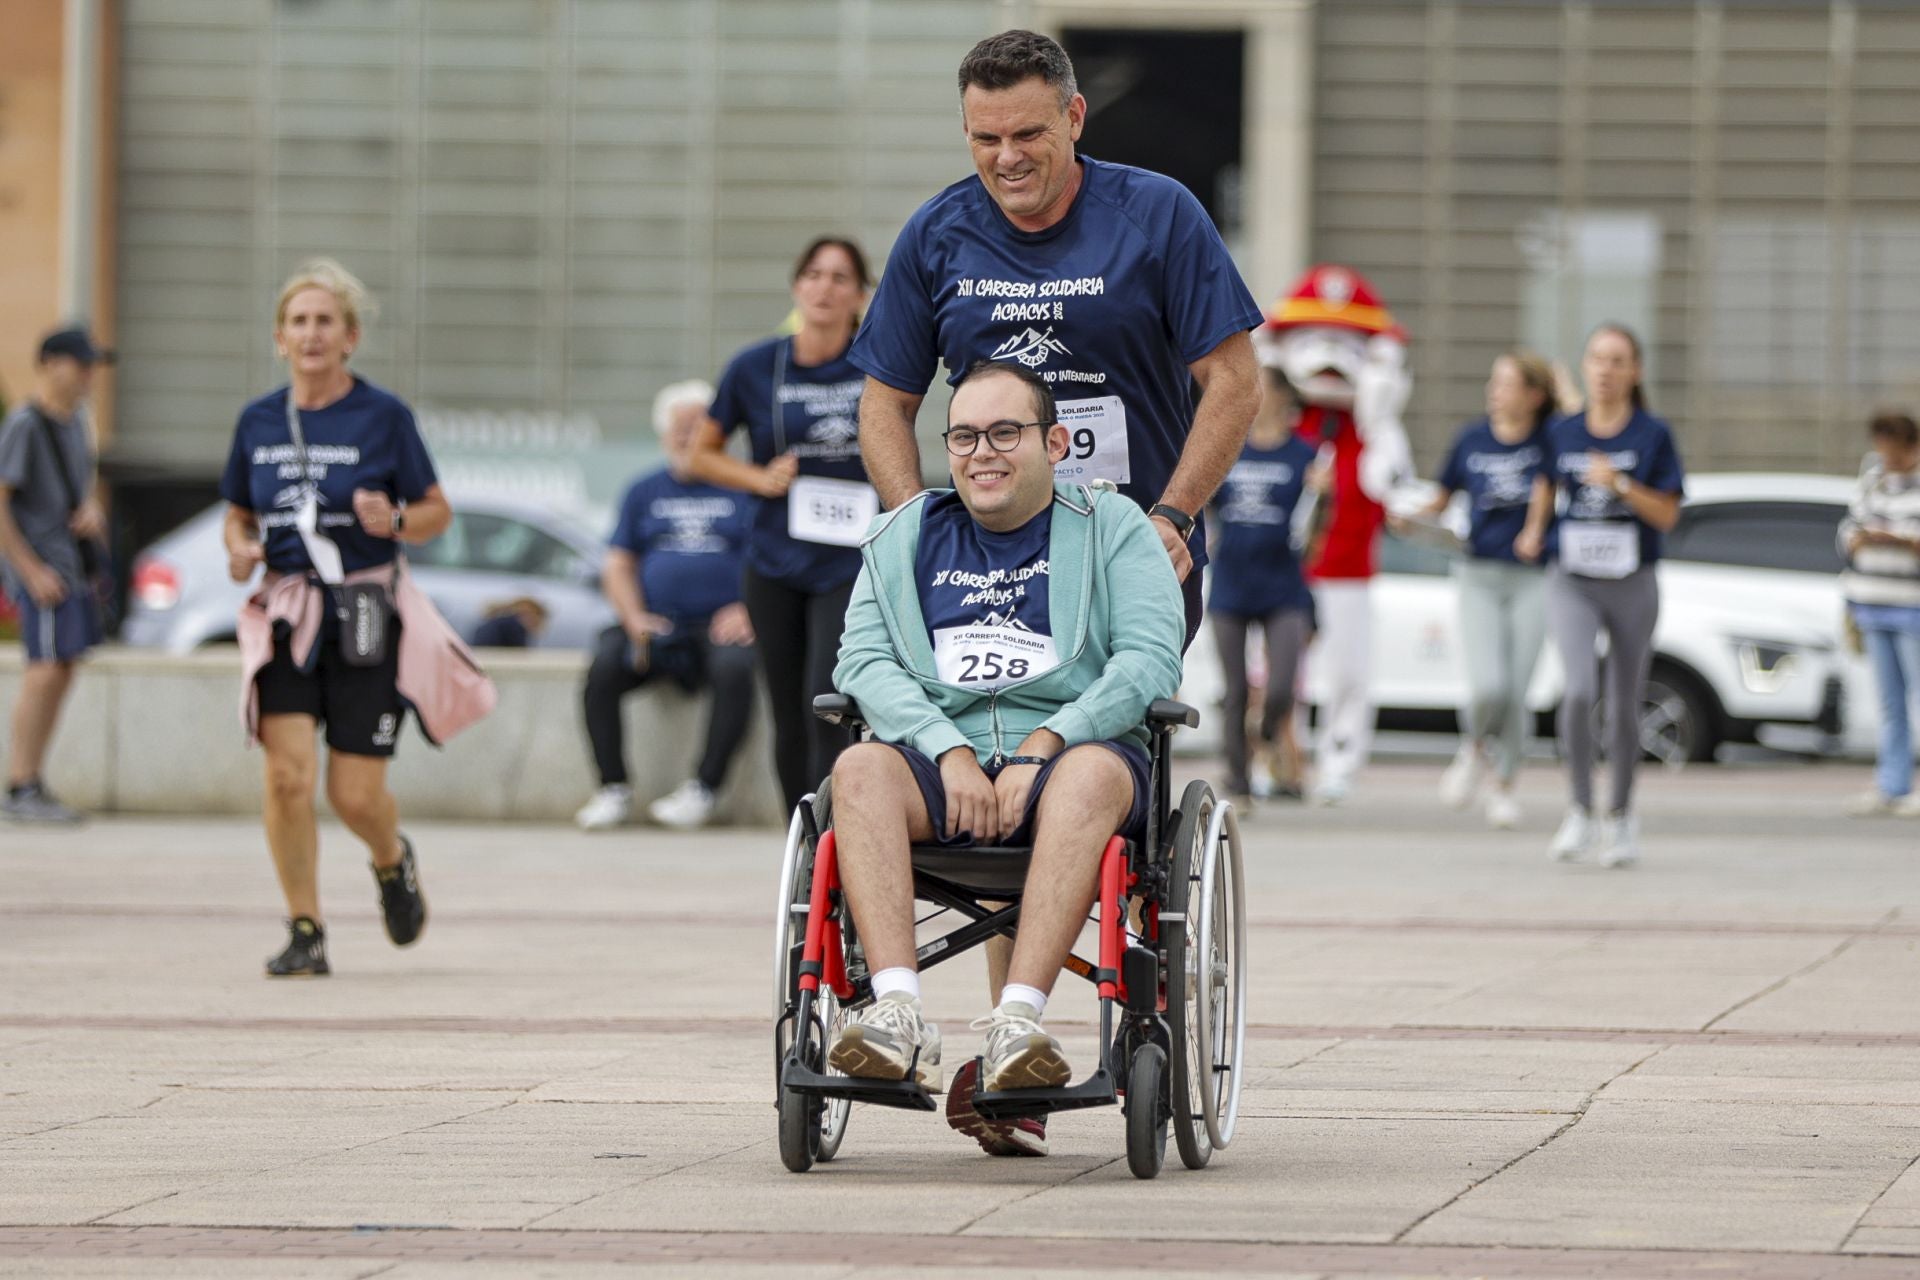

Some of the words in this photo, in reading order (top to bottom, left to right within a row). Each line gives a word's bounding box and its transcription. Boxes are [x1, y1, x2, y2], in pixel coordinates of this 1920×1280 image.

[957, 278, 974, 296] XII
[975, 279, 1036, 298] CARRERA
[1037, 276, 1104, 298] SOLIDARIA
[991, 302, 1050, 321] ACPACYS
[1053, 301, 1064, 320] 2025
[1043, 371, 1057, 383] NO
[1058, 369, 1106, 384] INTENTARLO
[1061, 405, 1104, 415] SOLIDARIA
[965, 632, 1001, 640] CARRERA
[1003, 634, 1045, 650] SOLIDARIA
[958, 652, 1030, 682] 258
